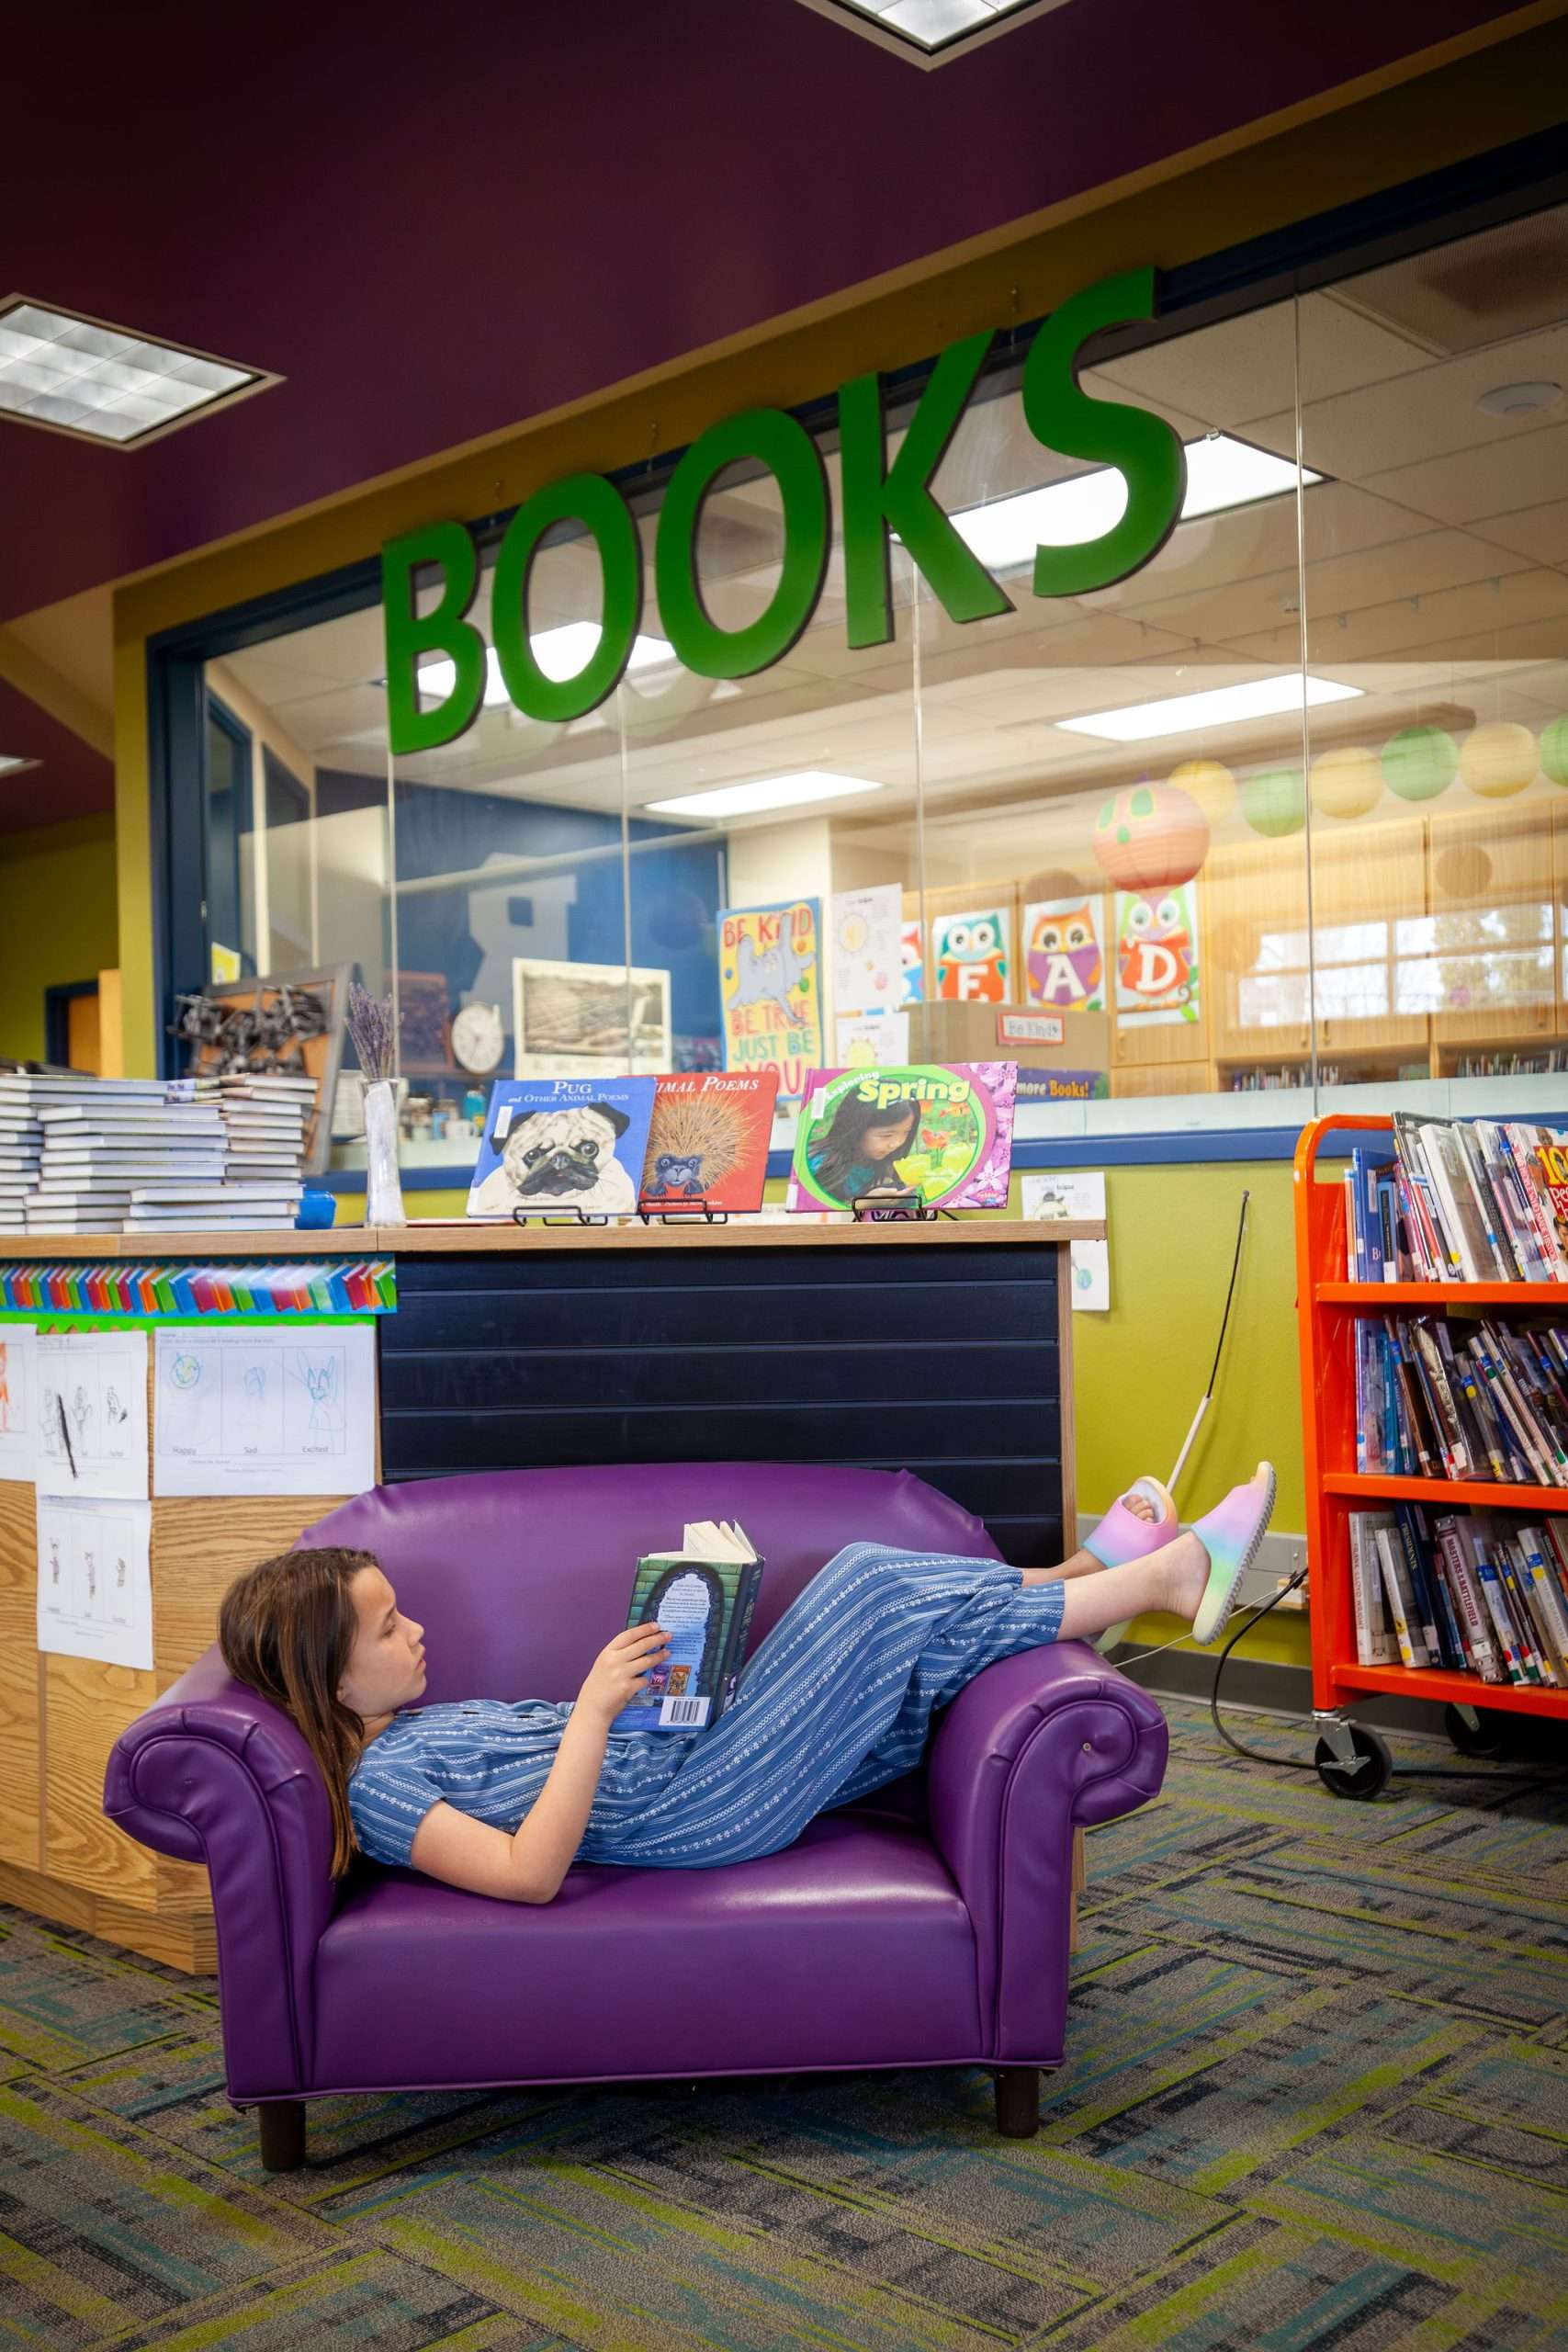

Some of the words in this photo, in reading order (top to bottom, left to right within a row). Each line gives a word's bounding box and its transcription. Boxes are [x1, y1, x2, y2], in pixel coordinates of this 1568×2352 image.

[381, 266, 1187, 754] BOOKS
[723, 918, 746, 947] BE
[731, 1009, 759, 1035] BE
[733, 1035, 778, 1062] JUST
[787, 1029, 815, 1056] BE
[508, 1094, 523, 1102] and
[656, 1081, 695, 1093] IMAL
[857, 1079, 970, 1109] Spring
[1016, 1082, 1046, 1096] more
[1050, 1079, 1089, 1098] Books!
[1537, 1147, 1568, 1186] 10
[173, 1448, 197, 1456] Happy
[1400, 1521, 1418, 1570] PRESIDENTS
[1446, 1537, 1462, 1574] MASTERS
[1460, 1578, 1479, 1626] BATTLEFIELD
[1356, 1600, 1364, 1629] WRIGHT
